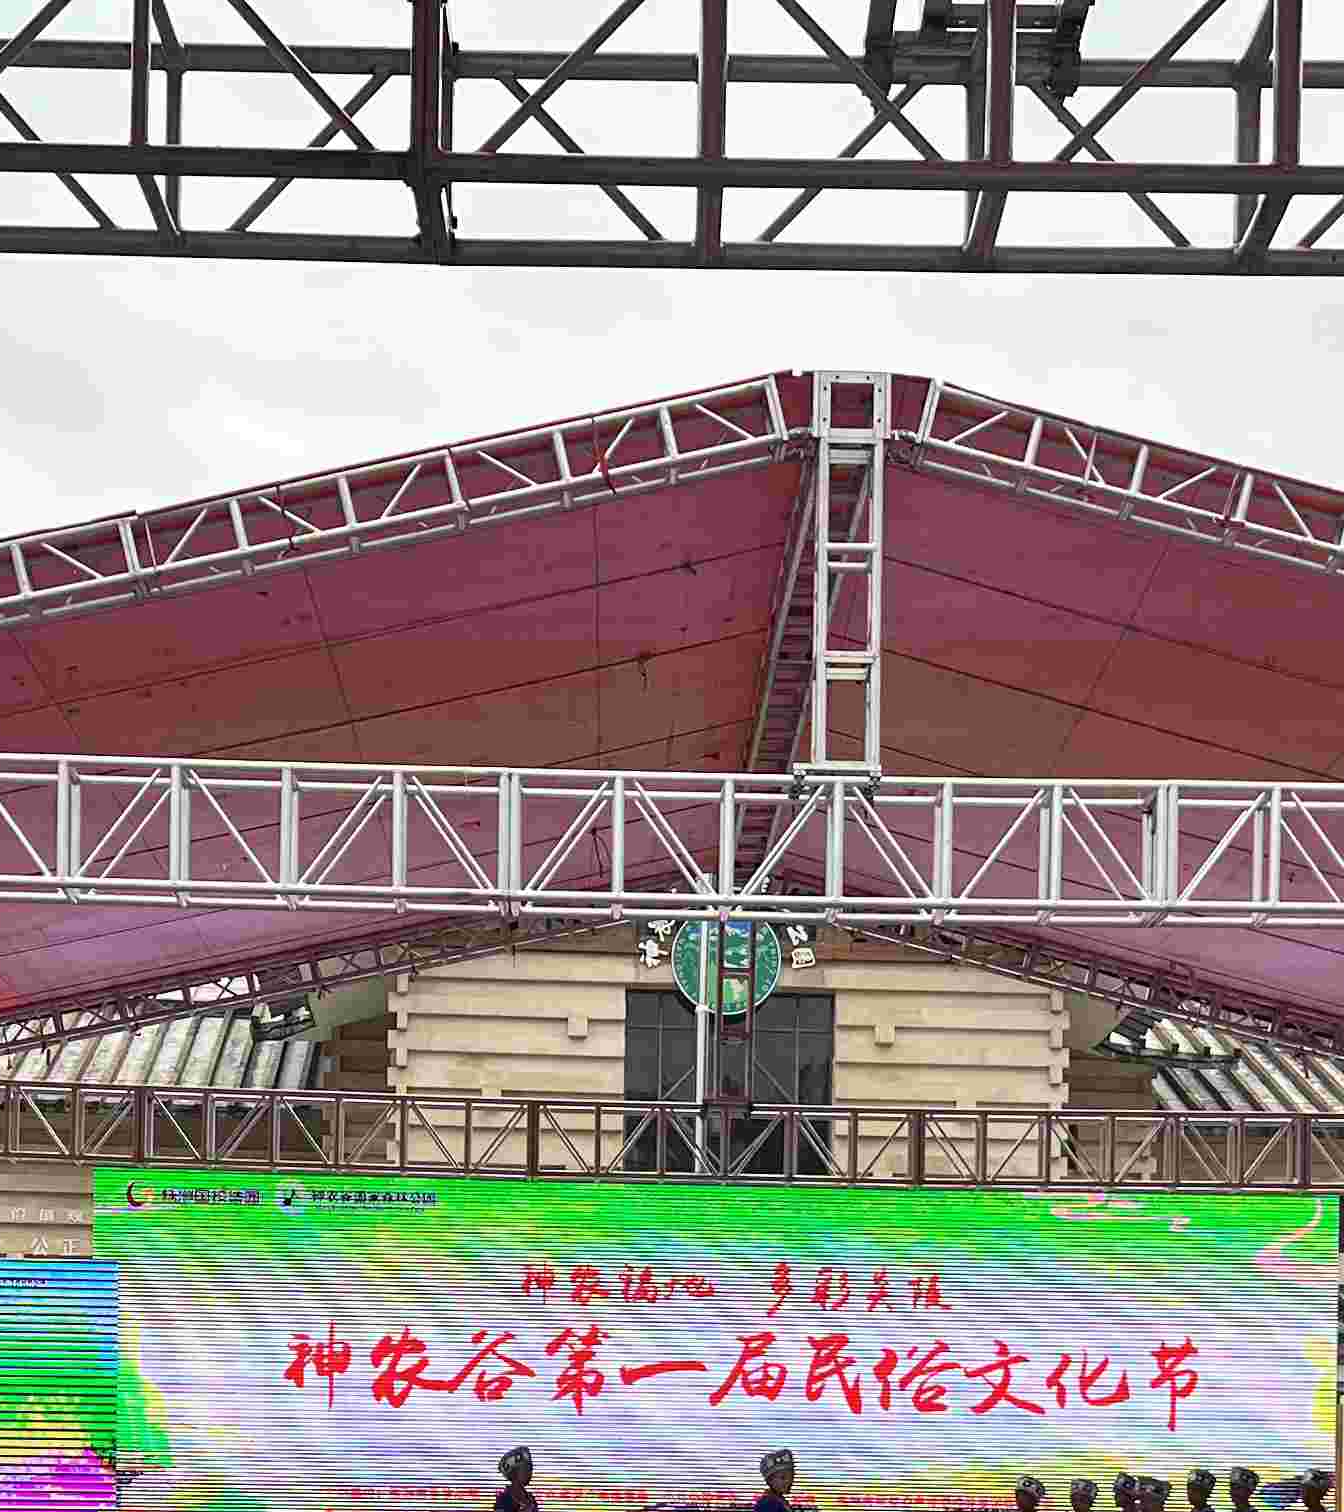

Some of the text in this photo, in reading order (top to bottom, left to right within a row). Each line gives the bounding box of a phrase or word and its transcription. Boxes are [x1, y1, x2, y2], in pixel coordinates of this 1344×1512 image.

[283, 1320, 1201, 1432] 神农谷第一届民俗文化节
